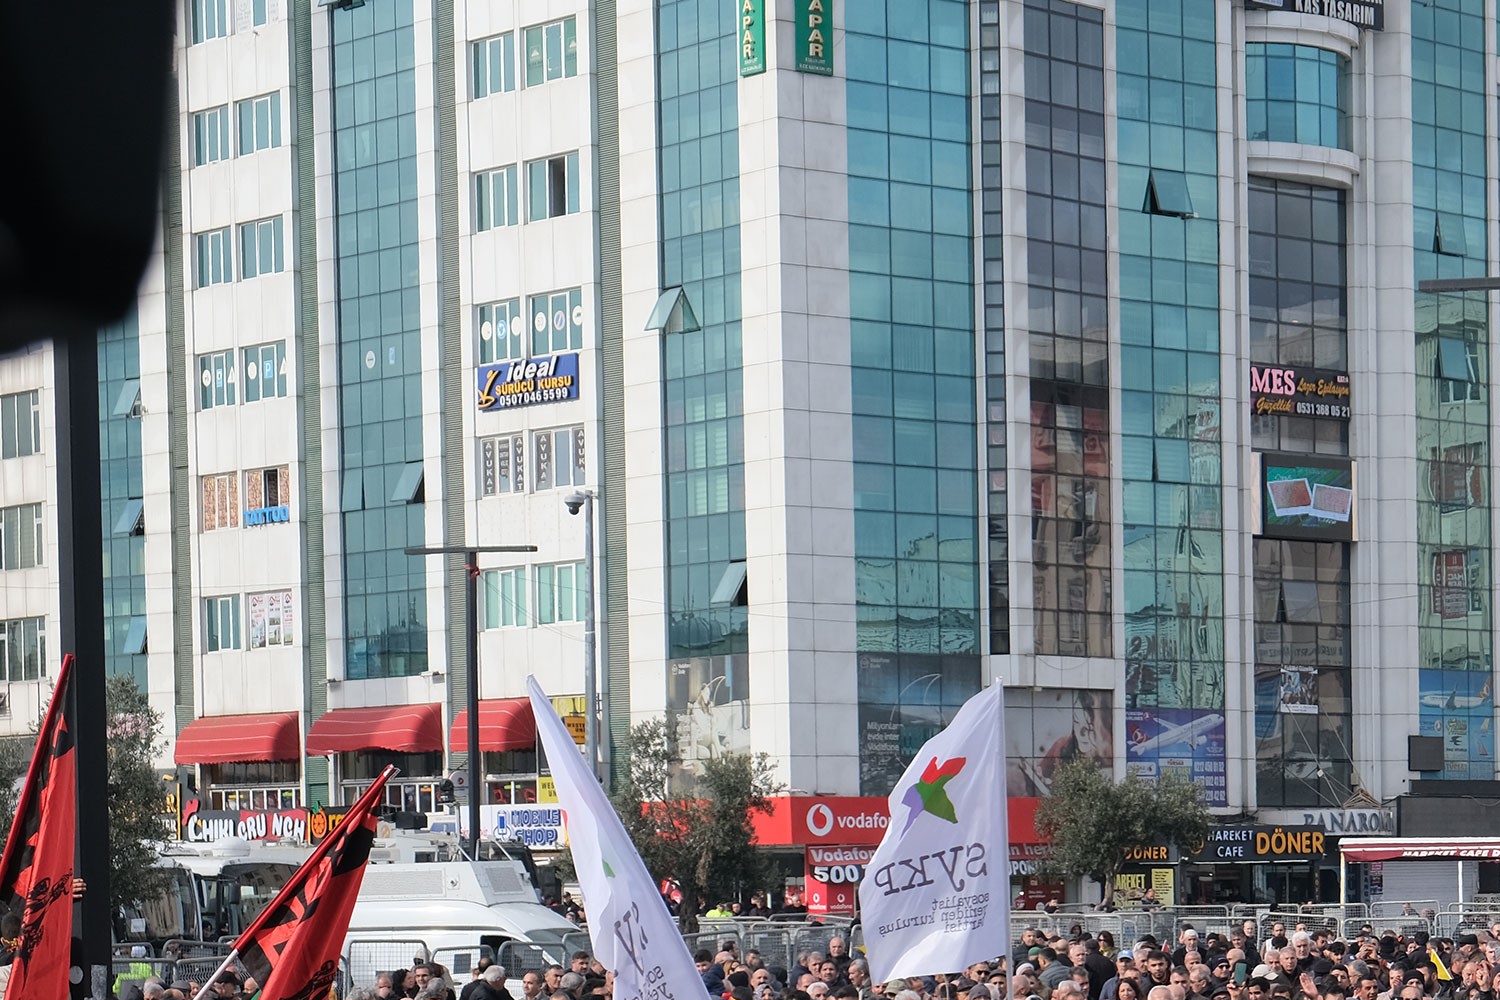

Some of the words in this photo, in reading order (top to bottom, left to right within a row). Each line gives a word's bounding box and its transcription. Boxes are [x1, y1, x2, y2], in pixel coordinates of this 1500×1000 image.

[1323, 0, 1375, 26] TASARIM
[506, 355, 557, 382] ideal
[495, 378, 535, 396] SÜRÜCÜ
[537, 375, 572, 390] KURSU
[1251, 366, 1296, 396] MES
[1296, 401, 1315, 415] 0531
[1331, 404, 1341, 417] 05
[1341, 405, 1350, 417] 21
[485, 442, 493, 493] AVUKAT
[540, 435, 548, 483] AVUKA
[244, 506, 289, 527] TATTOO
[541, 782, 554, 790] WES
[837, 811, 892, 830] vodafo
[1207, 829, 1254, 842] HAREKET
[1256, 827, 1325, 855] DÖNER
[1217, 845, 1244, 858] CAFE
[1459, 849, 1490, 857] CAFE
[814, 864, 859, 884] 500
[1115, 873, 1146, 889] AREKET
